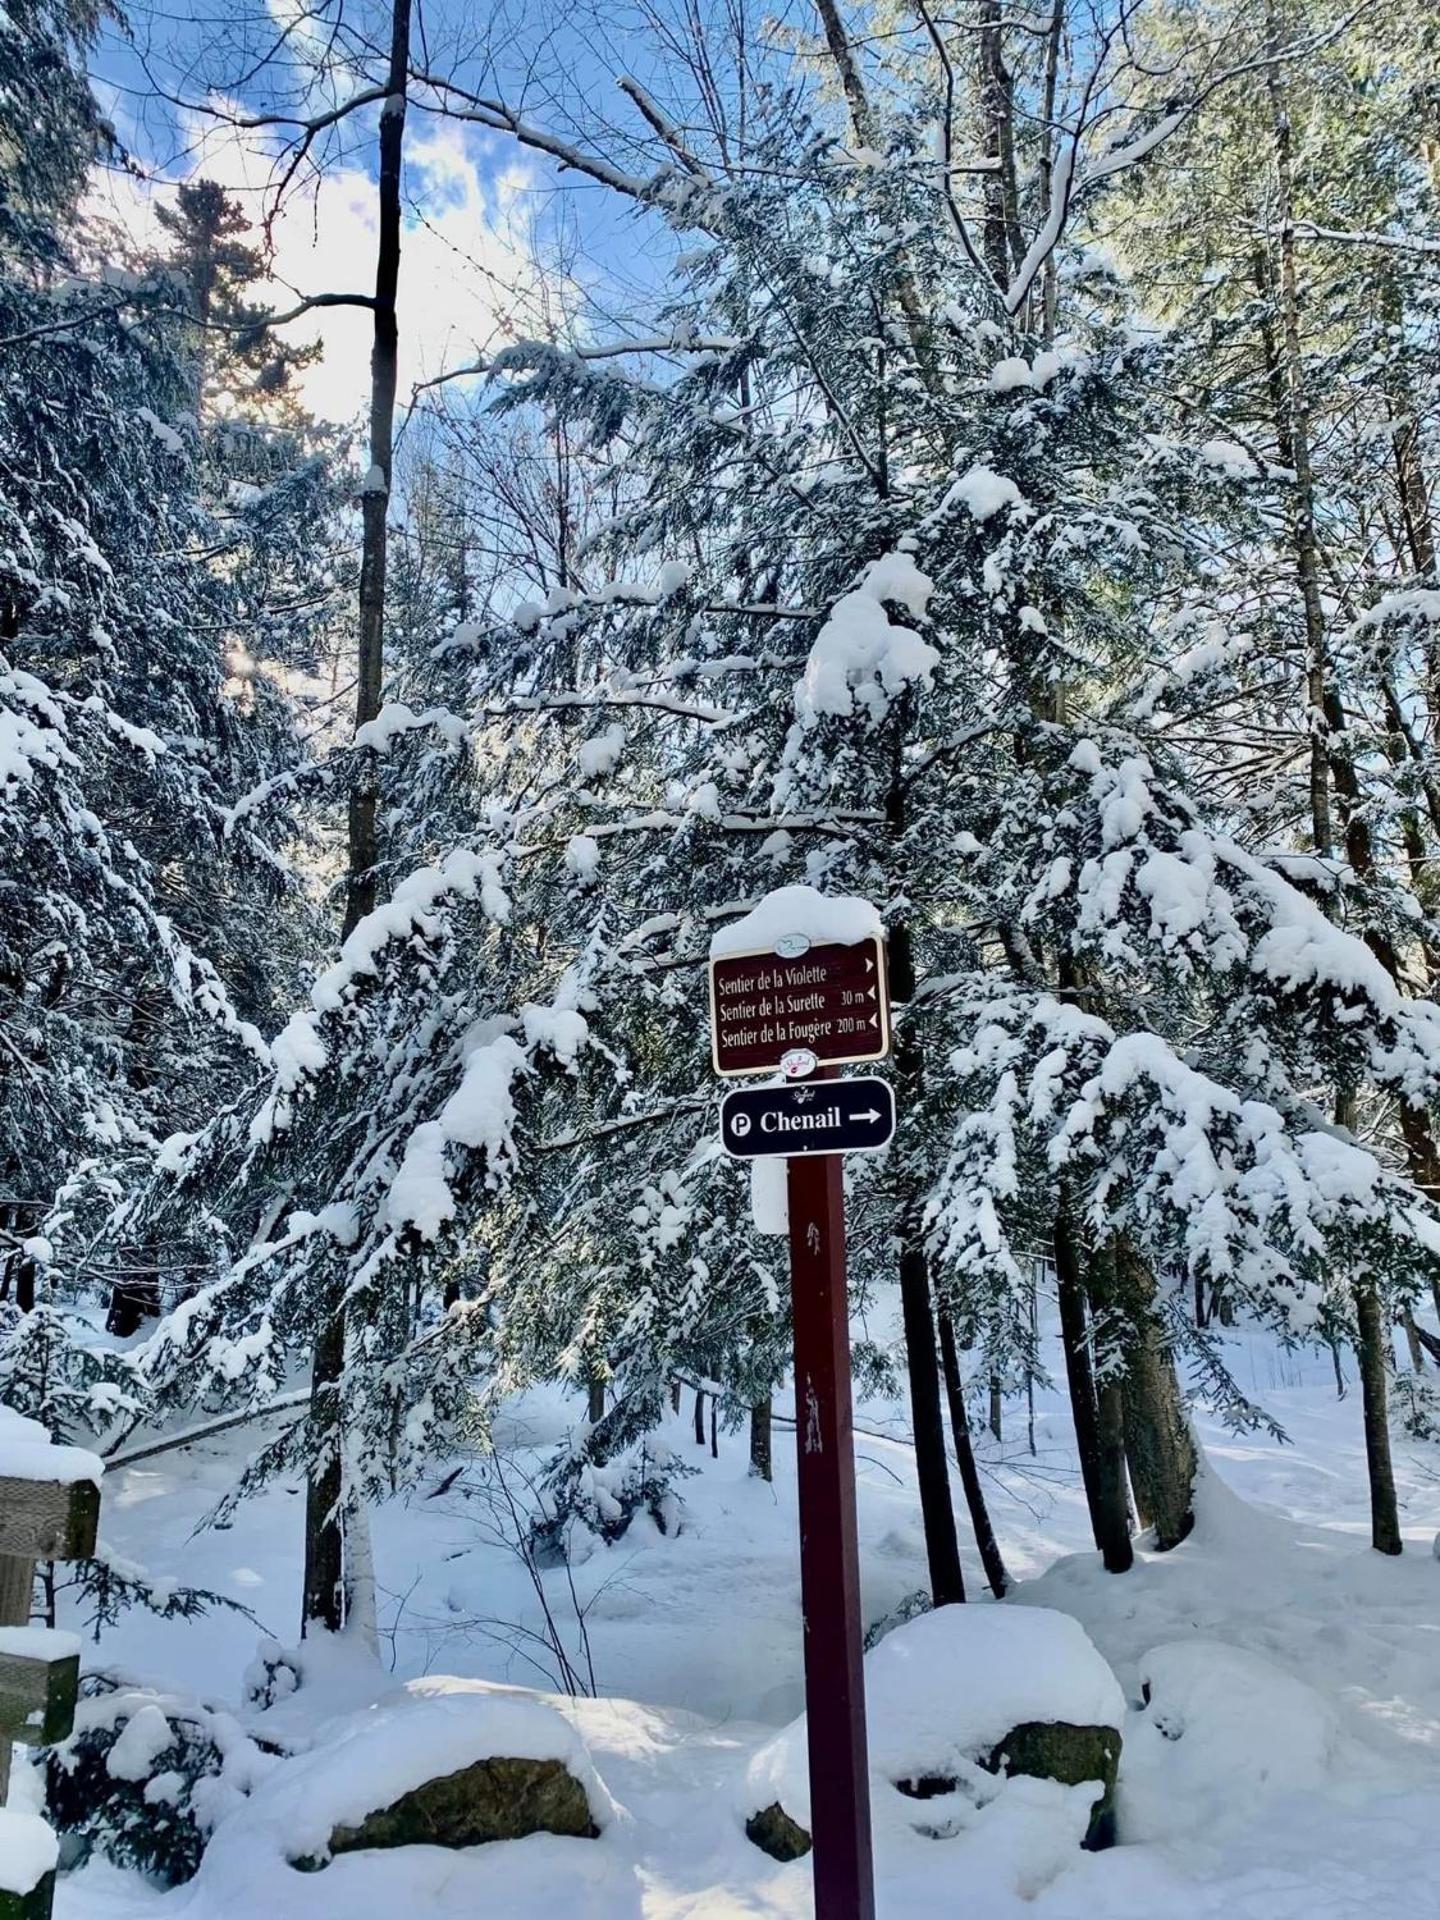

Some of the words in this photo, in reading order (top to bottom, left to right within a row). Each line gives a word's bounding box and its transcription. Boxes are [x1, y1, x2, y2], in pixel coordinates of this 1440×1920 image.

[718, 973, 754, 996] Sentier
[757, 970, 770, 990] de
[773, 968, 783, 988] la
[785, 966, 827, 986] Violette
[720, 1000, 756, 1022] Sentier
[759, 997, 772, 1016] de
[775, 995, 784, 1015] la
[787, 993, 825, 1013] Surette
[841, 990, 853, 1006] 30
[855, 992, 864, 1004] m
[721, 1026, 757, 1048] Sentier
[760, 1023, 773, 1043] de
[776, 1022, 786, 1041] la
[789, 1018, 832, 1044] Fougère
[837, 1018, 854, 1034] 200
[856, 1020, 866, 1031] m
[760, 1106, 842, 1133] Chenail
